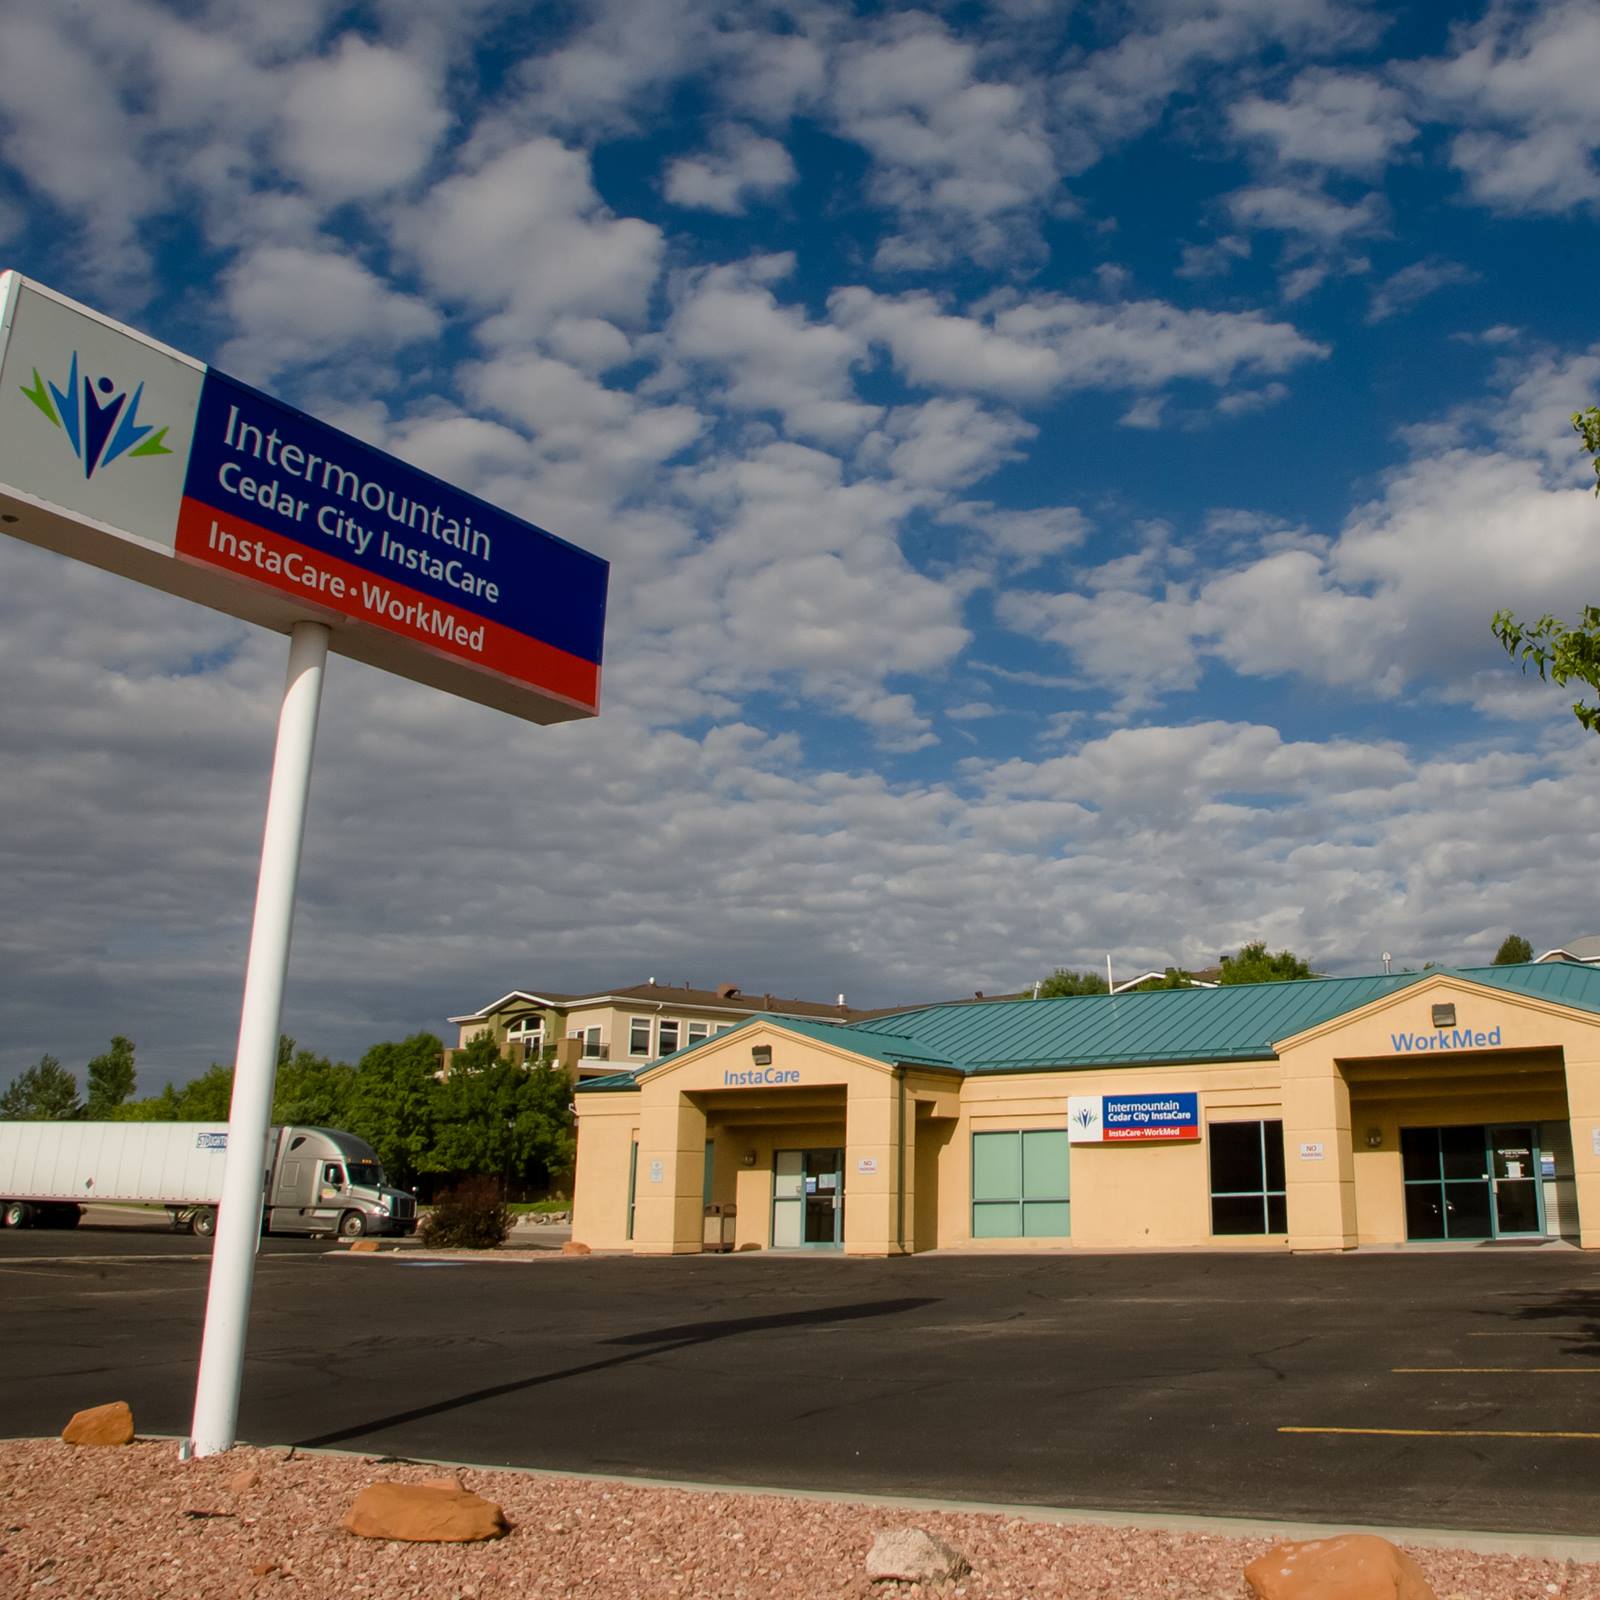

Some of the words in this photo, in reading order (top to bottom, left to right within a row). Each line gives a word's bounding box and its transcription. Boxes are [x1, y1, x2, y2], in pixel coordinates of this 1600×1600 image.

[223, 405, 491, 561] Intermountain
[218, 462, 309, 522] Cedar
[317, 505, 373, 555] City
[380, 530, 500, 604] InstaCare
[1391, 1025, 1502, 1052] WorkMed
[724, 1067, 800, 1086] InstaCare
[1107, 1100, 1179, 1113] Intermountain
[1107, 1112, 1131, 1122] Cedar
[1133, 1111, 1149, 1123] City
[1151, 1110, 1191, 1121] InstaCare
[1305, 1144, 1317, 1152] NO
